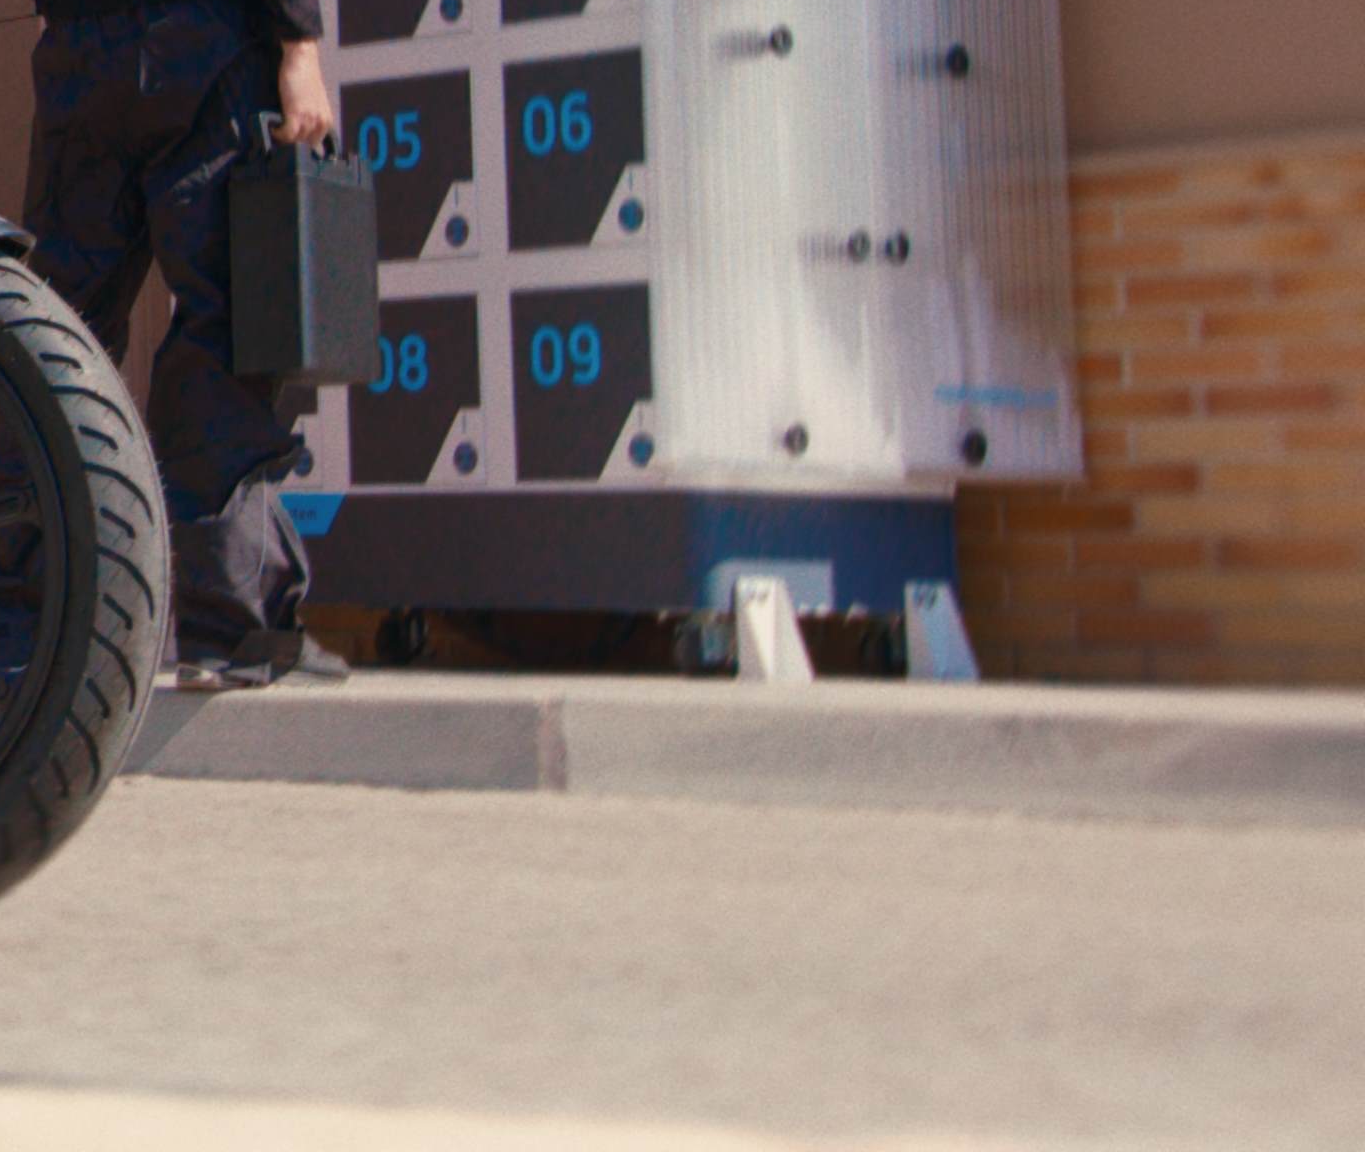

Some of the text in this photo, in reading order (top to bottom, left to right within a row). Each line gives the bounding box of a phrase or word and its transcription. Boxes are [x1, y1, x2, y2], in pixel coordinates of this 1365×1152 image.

[358, 110, 422, 173] 05
[522, 90, 593, 156] 06
[368, 333, 429, 393] 08
[530, 321, 602, 387] 09
